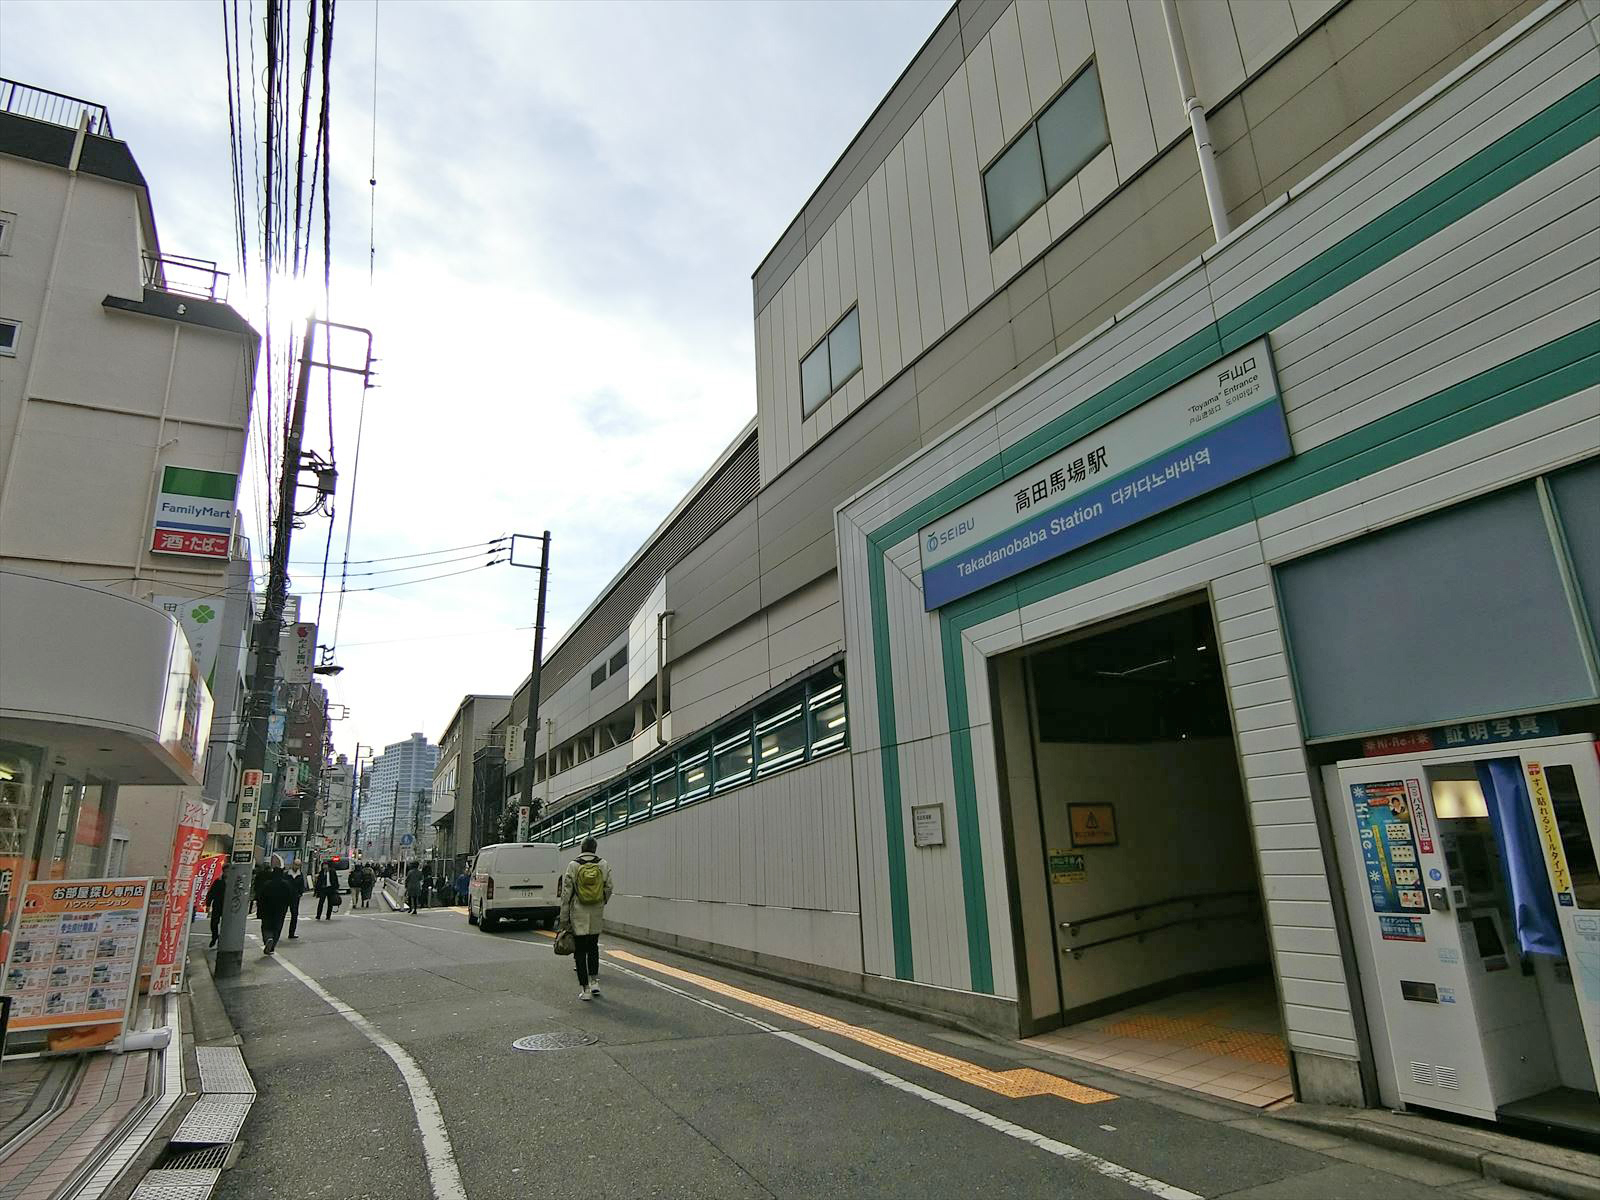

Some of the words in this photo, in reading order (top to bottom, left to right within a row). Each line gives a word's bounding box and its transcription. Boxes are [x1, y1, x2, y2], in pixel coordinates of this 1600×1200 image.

[1217, 357, 1256, 388] 戸山口
[1223, 374, 1258, 396] Entrance
[1013, 445, 1109, 514] 高田馬場駅
[1110, 447, 1211, 505] 다카다노바바역
[161, 502, 231, 518] FamilyMart
[939, 517, 975, 545] SEIBU
[956, 527, 1048, 577] Takadanobaba
[1050, 501, 1103, 536] Station
[1445, 716, 1540, 744] 証明写真
[53, 885, 144, 900] お部屋探し専門店
